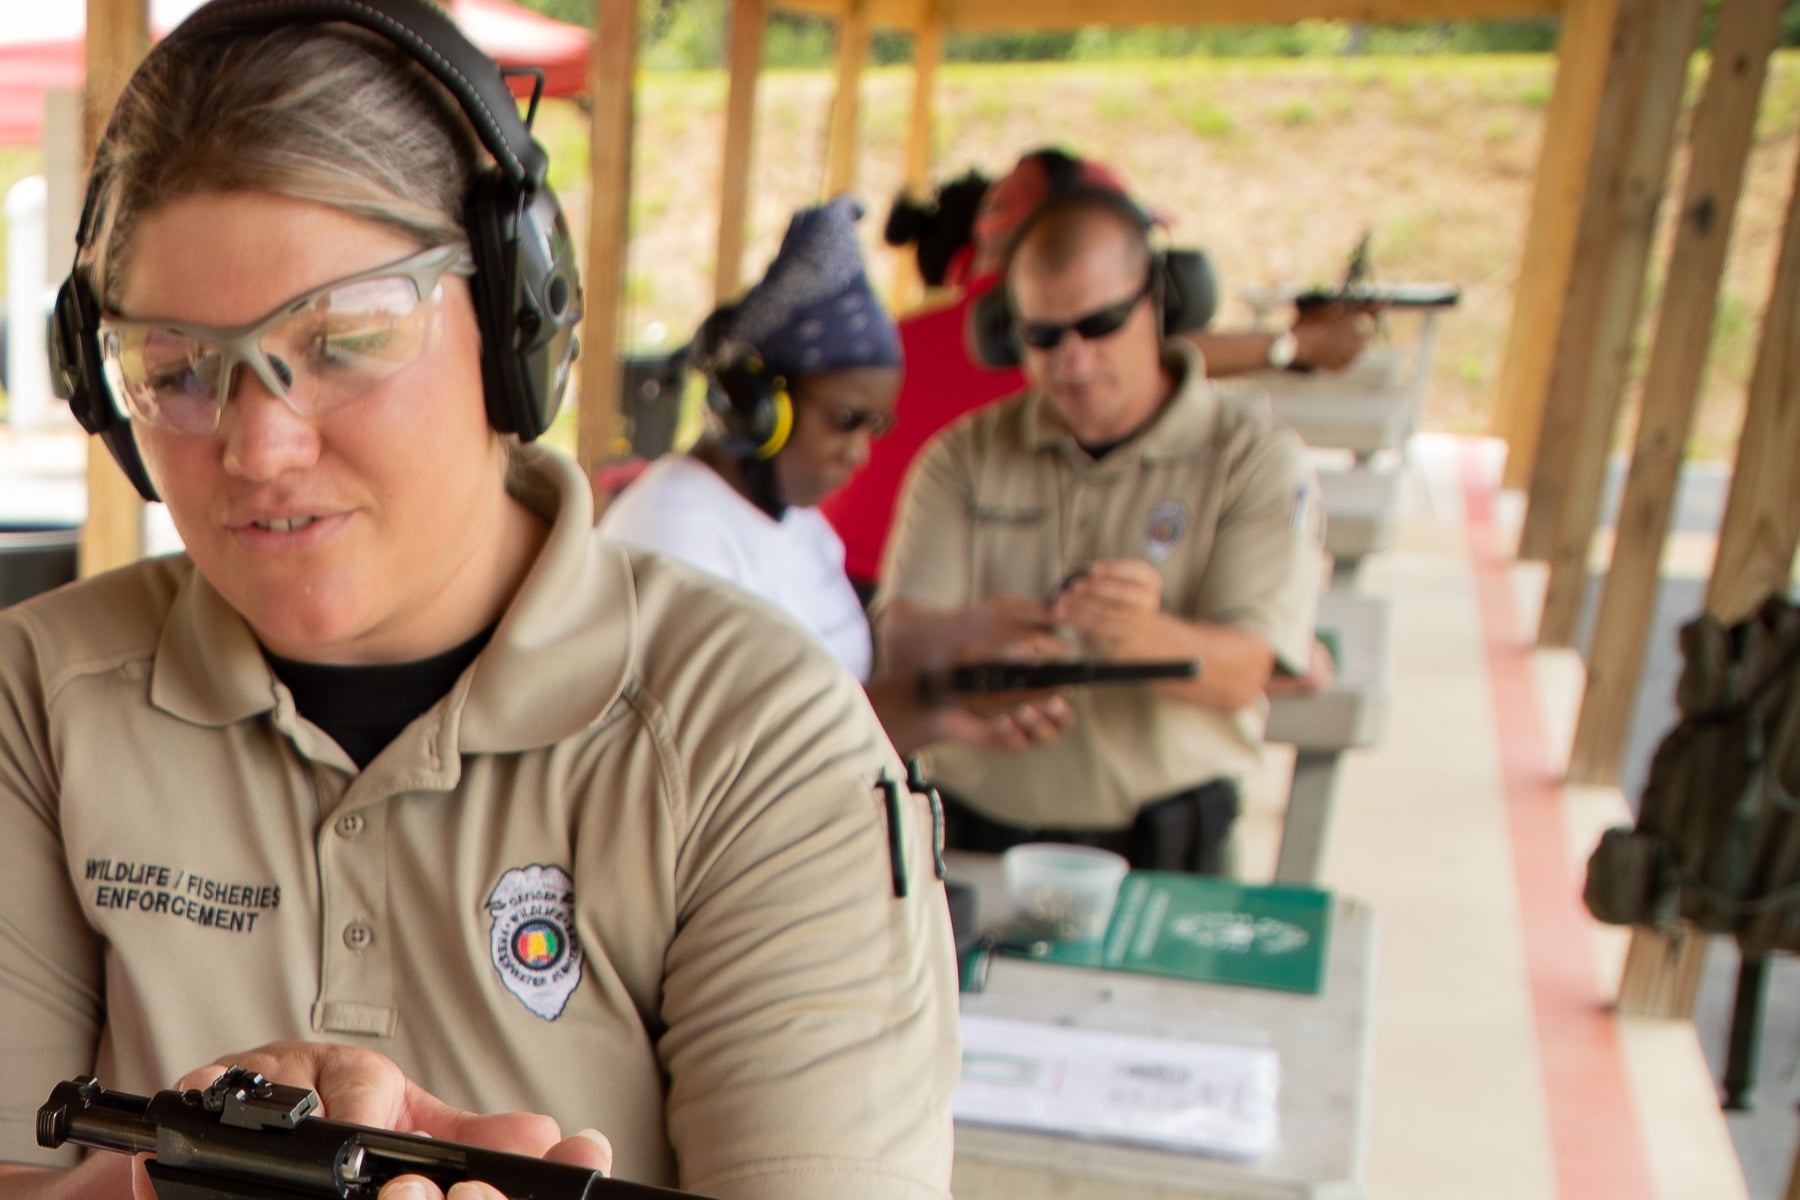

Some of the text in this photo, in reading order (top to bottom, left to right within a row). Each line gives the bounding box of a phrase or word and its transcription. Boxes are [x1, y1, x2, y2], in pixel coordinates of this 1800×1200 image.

[85, 858, 282, 908] WILDLIFE / FISHERIES
[95, 886, 260, 932] ENFORCEMENT
